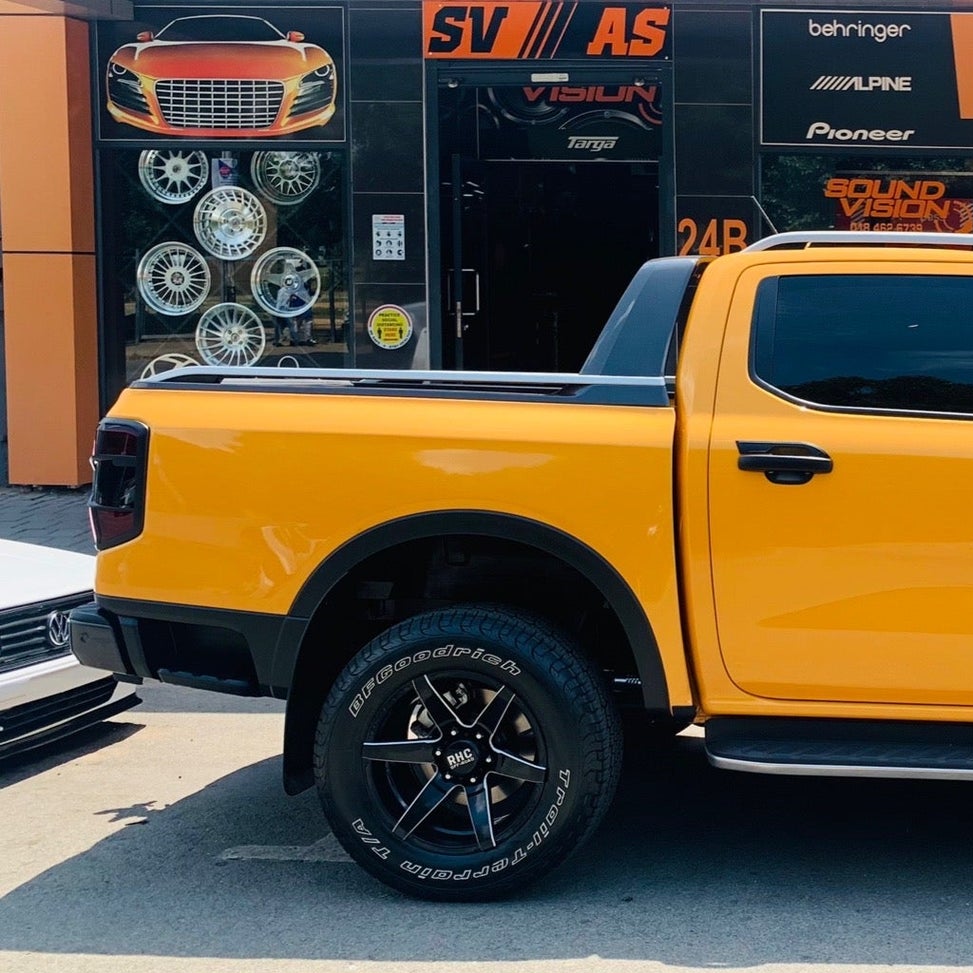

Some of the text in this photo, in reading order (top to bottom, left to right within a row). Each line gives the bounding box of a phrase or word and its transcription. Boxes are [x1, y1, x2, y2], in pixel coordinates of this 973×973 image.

[428, 8, 670, 57] SV AS
[808, 19, 911, 42] behringer
[828, 76, 911, 91] ALPINE
[806, 122, 915, 141] Pioneer
[567, 136, 619, 152] Targa
[824, 178, 946, 200] SOUND
[839, 198, 951, 219] VISION
[678, 218, 748, 256] 24B
[447, 748, 473, 766] RHC
